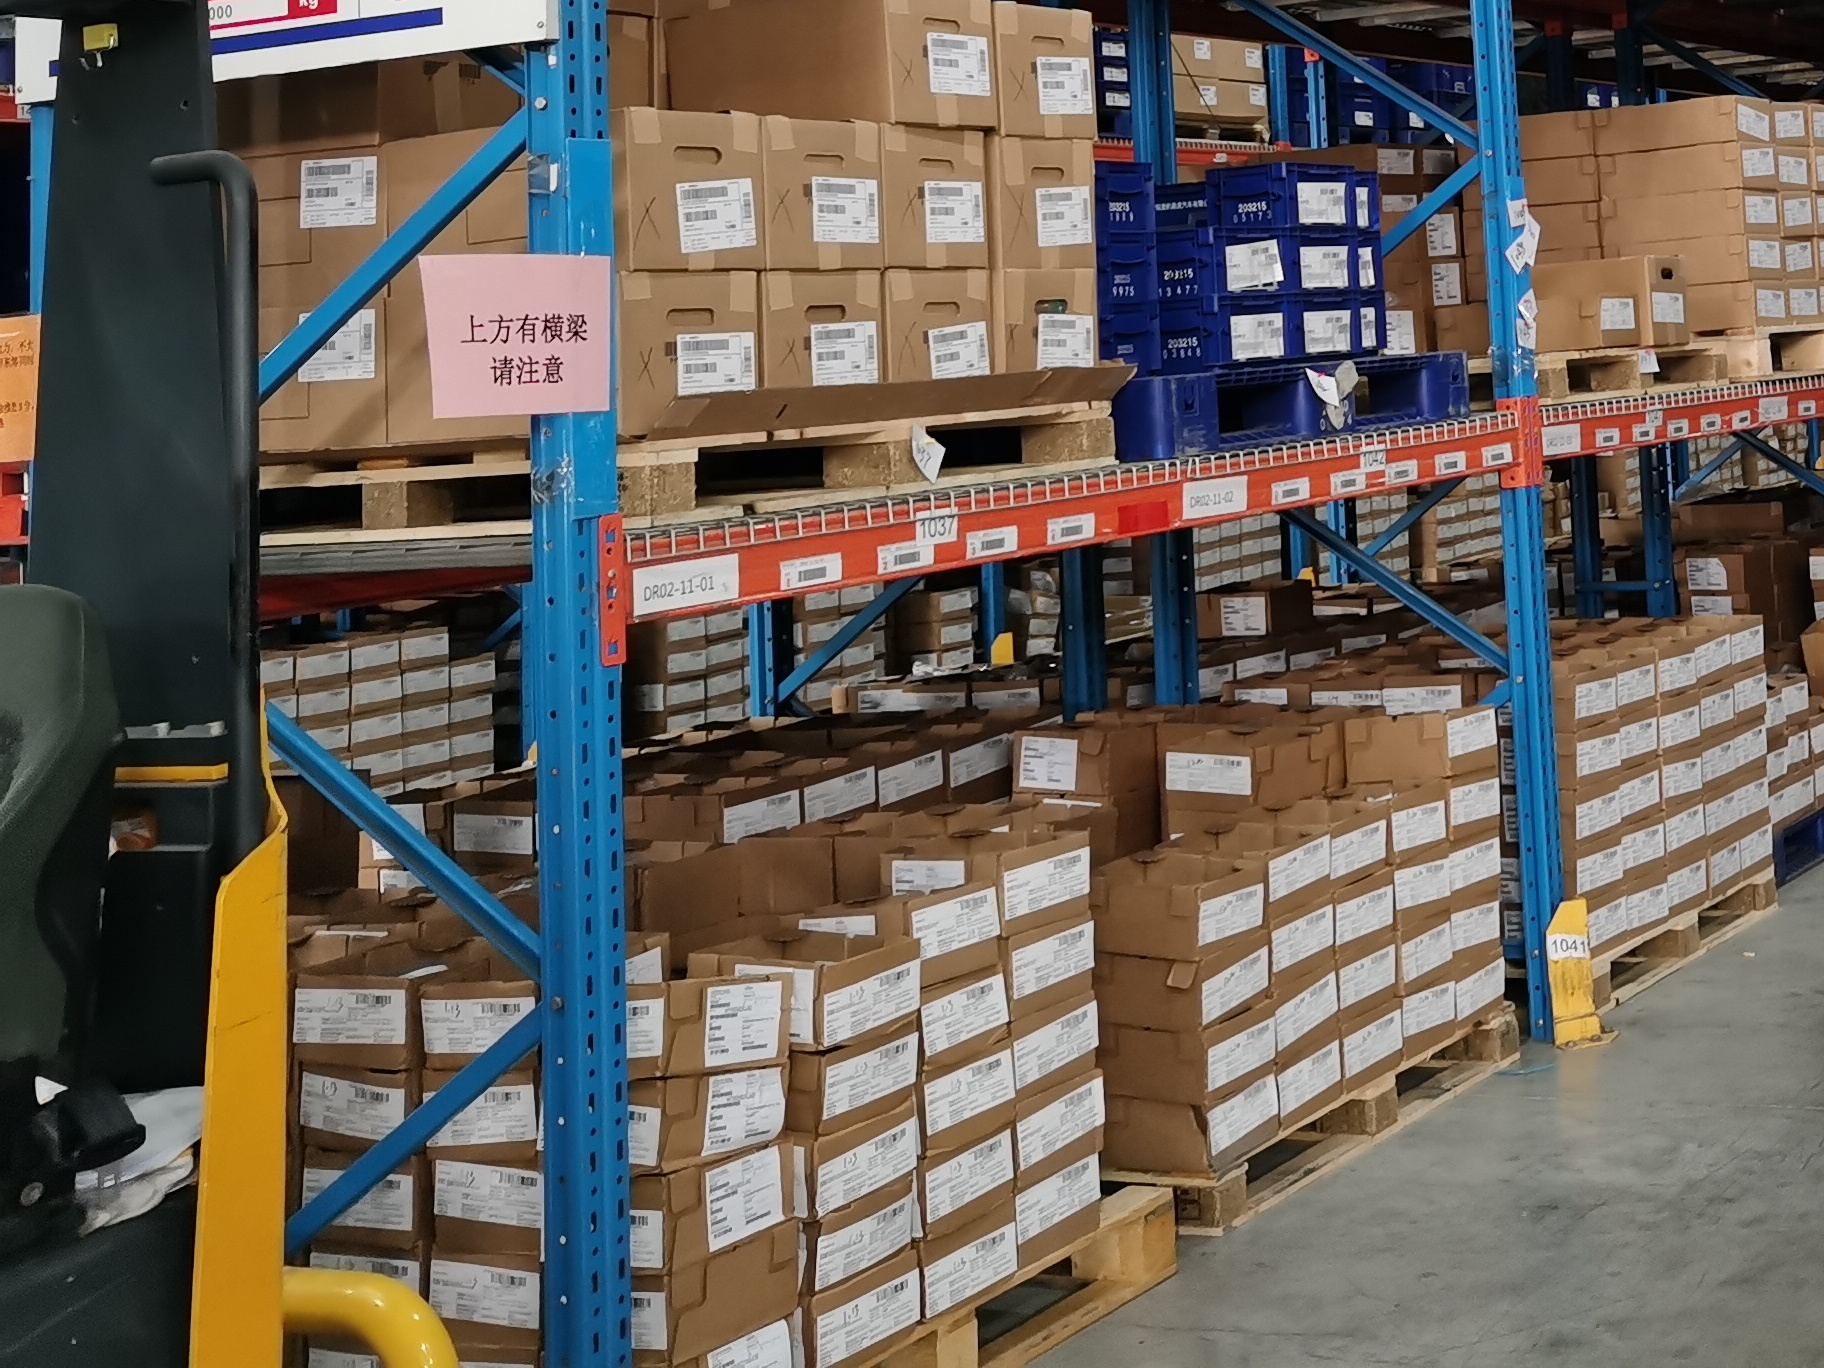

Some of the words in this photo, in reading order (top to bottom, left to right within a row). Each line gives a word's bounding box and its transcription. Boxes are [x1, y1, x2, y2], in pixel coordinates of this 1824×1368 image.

[208, 4, 233, 20] 000
[1237, 201, 1268, 213] 203215
[459, 312, 588, 345] 上方有横梁
[489, 355, 565, 386] 请注意
[1362, 450, 1386, 468] 1042
[920, 516, 957, 539] 1037
[643, 575, 715, 602] DR02-11-01
[1551, 938, 1588, 954] 1041
